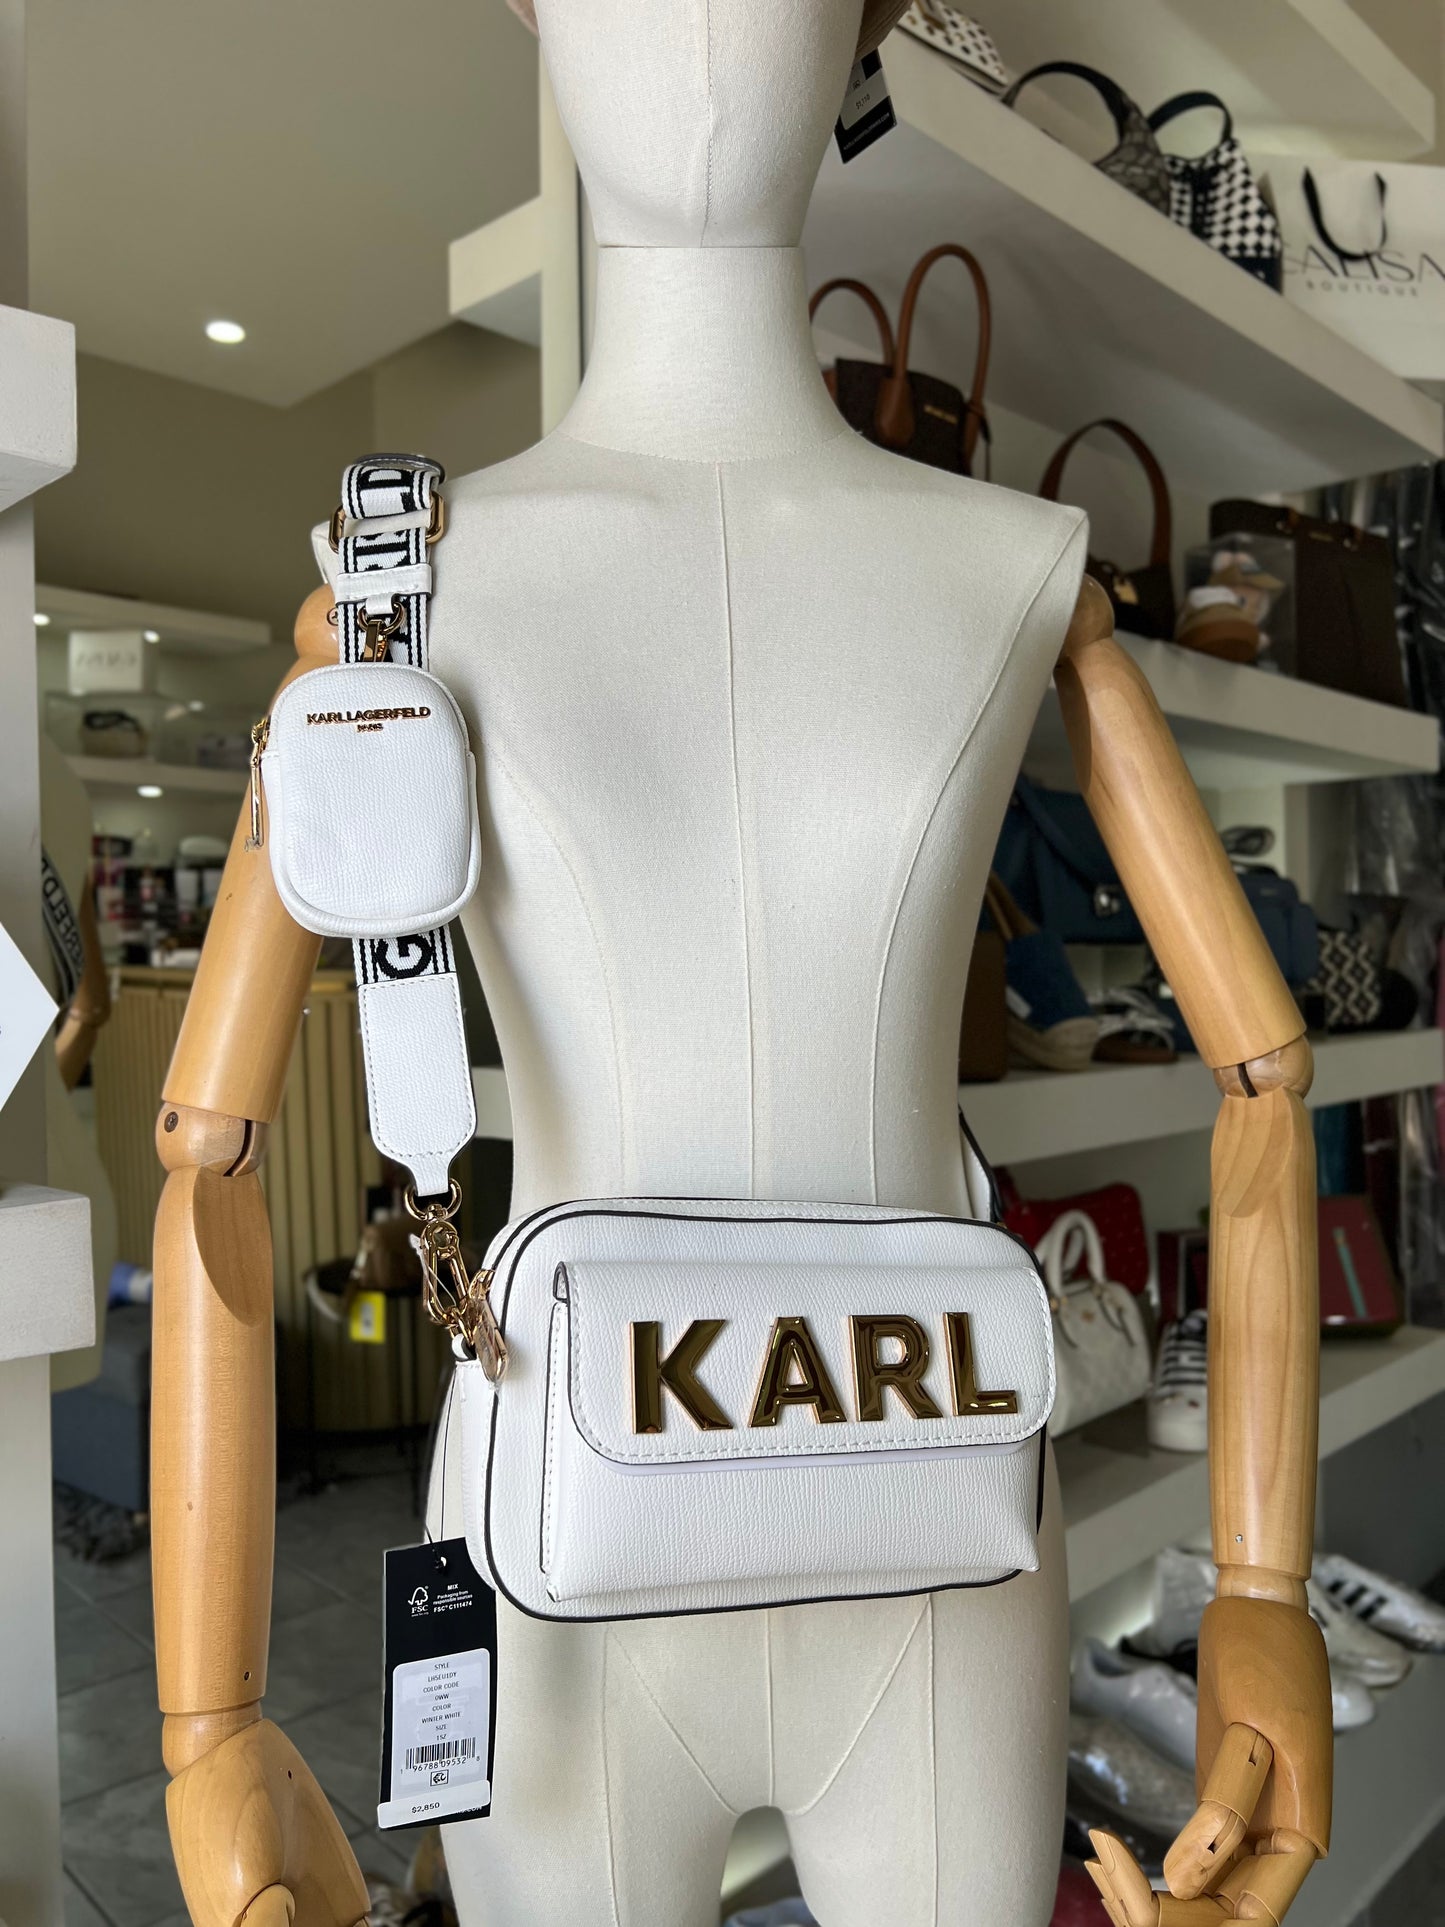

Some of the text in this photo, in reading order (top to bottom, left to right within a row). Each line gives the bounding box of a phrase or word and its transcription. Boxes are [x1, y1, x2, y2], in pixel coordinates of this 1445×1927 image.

[306, 706, 432, 725] KARL LAGERFELD
[629, 1311, 1019, 1435] KARL
[411, 1604, 429, 1613] FSC
[434, 1662, 450, 1670] STYLE
[422, 1681, 460, 1693] COLOR CODE
[432, 1703, 452, 1712] COLOR
[421, 1711, 461, 1723] WINTER WHITE
[412, 1761, 439, 1773] 96788
[440, 1756, 467, 1768] 09532
